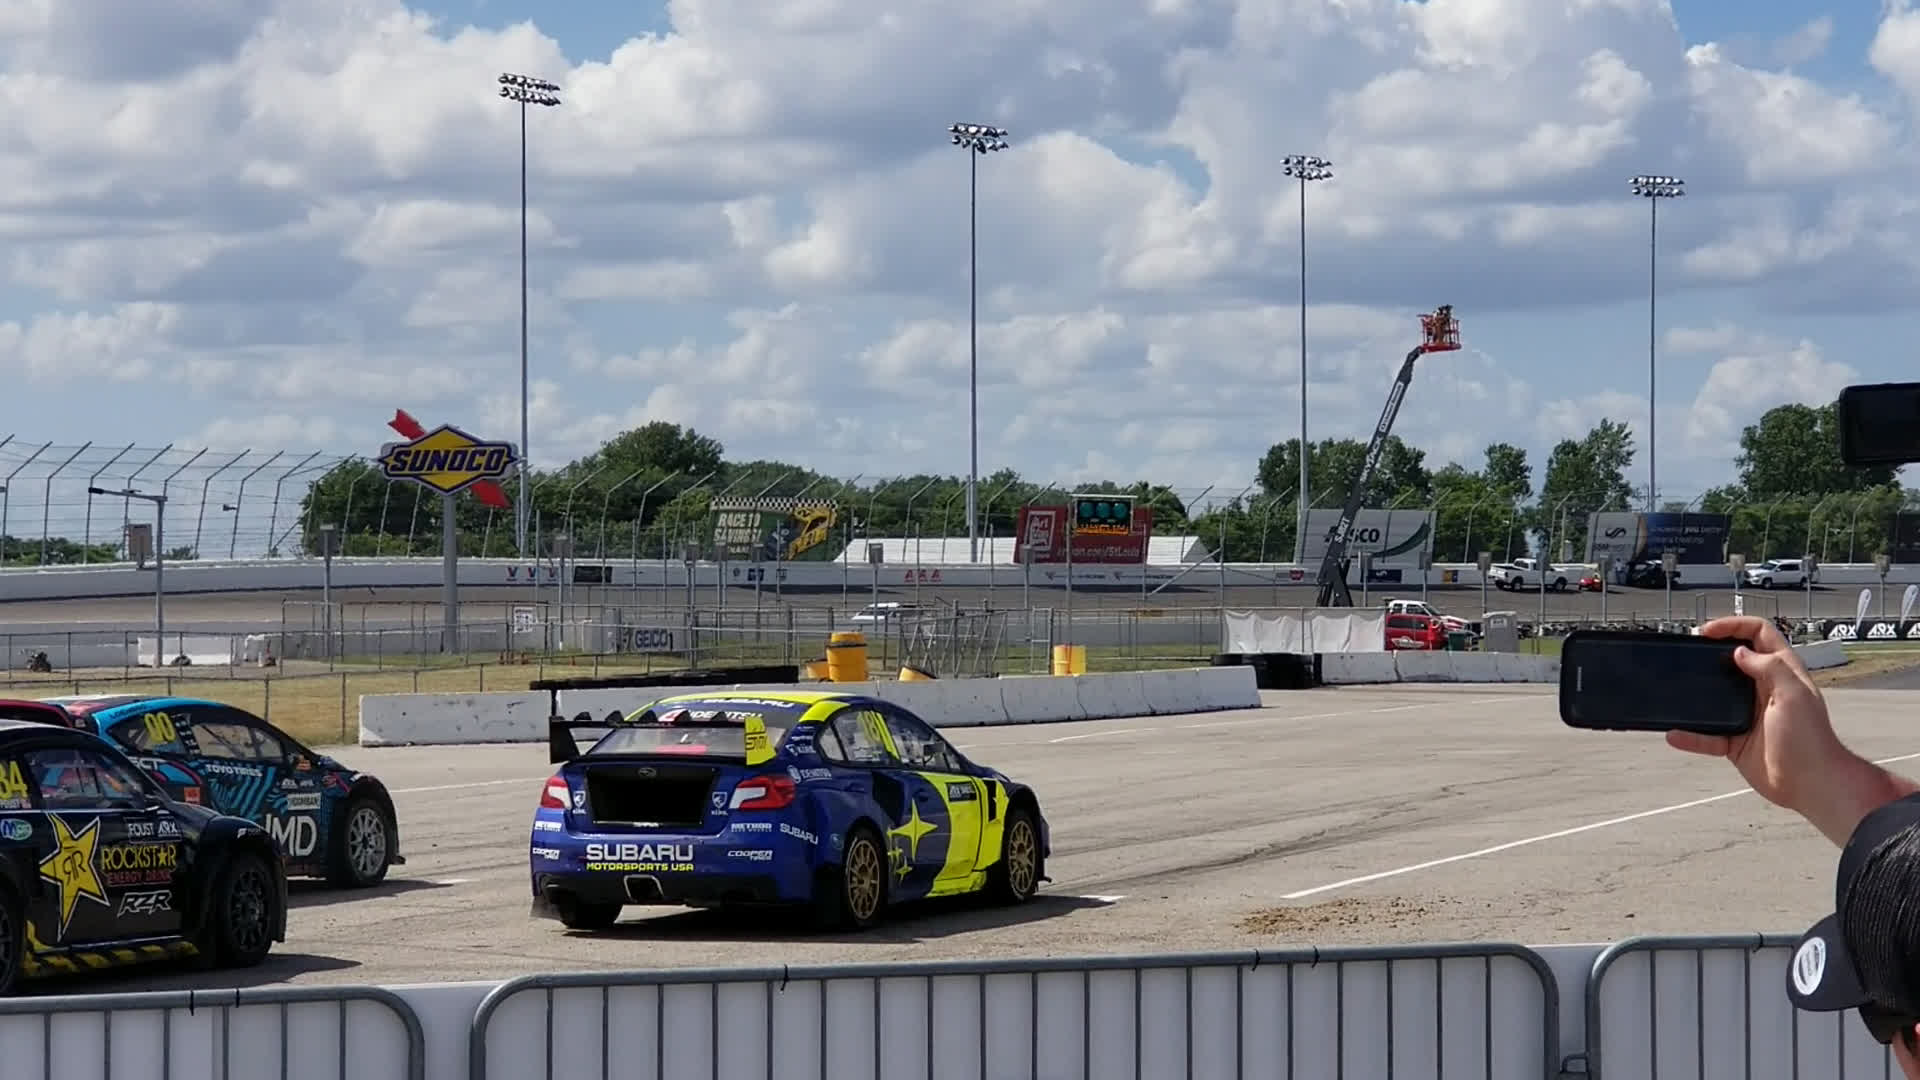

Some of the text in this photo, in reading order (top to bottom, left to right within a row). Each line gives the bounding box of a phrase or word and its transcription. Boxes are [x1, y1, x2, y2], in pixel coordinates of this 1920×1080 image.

[389, 447, 507, 473] SUNOCO
[717, 512, 748, 528] RACE
[635, 629, 669, 649] GEICO
[1828, 623, 1858, 639] ARX
[1866, 622, 1898, 639] ARX
[128, 822, 154, 837] FOUST
[779, 822, 819, 845] SUBARU
[102, 844, 177, 872] ROCKSTAR
[586, 842, 694, 862] SUBARU
[727, 850, 774, 858] COOPER
[586, 862, 695, 873] MOTORSPORTS USA
